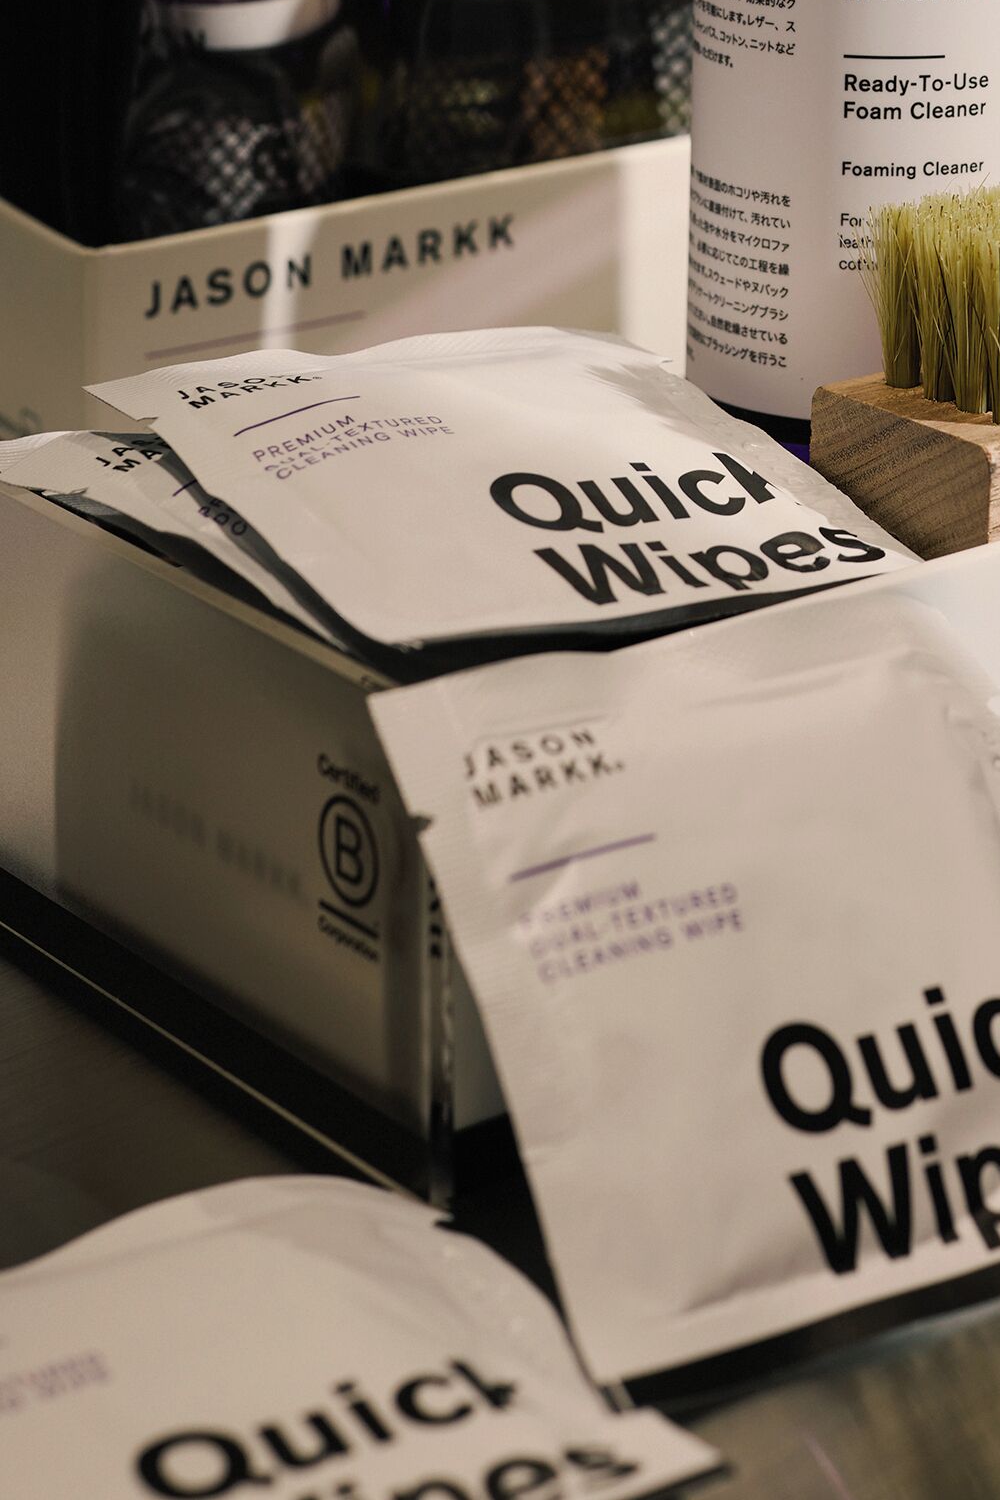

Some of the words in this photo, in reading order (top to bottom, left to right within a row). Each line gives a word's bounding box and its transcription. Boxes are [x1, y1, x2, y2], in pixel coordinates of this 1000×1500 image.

[844, 73, 989, 96] Ready-To-Use
[843, 101, 901, 120] Foam
[910, 102, 987, 119] Cleaner
[842, 162, 916, 179] Foaming
[923, 161, 984, 176] Cleaner
[145, 254, 311, 319] JASON
[342, 215, 516, 279] MARKK
[178, 375, 285, 400] JASO
[253, 415, 355, 463] PREMIUM
[276, 431, 391, 480] CLEANING
[398, 426, 455, 438] WIPE
[533, 527, 886, 606] Wipes
[464, 729, 595, 780] JASON
